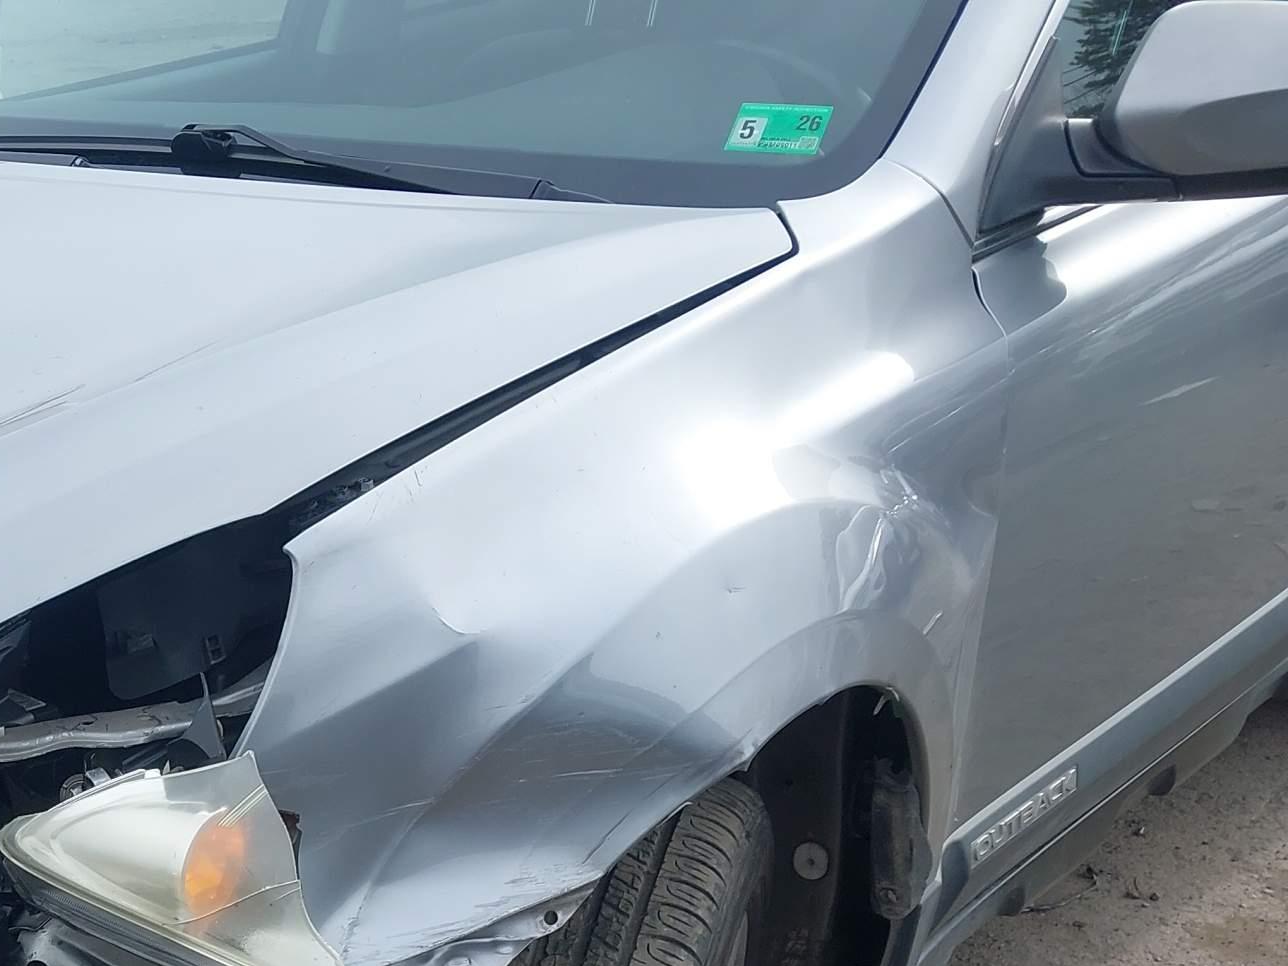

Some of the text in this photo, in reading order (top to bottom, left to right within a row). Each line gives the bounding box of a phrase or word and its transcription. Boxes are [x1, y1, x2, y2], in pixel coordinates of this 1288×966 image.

[739, 119, 757, 140] 5
[796, 115, 823, 132] 26
[974, 767, 1077, 861] OUTBACK
